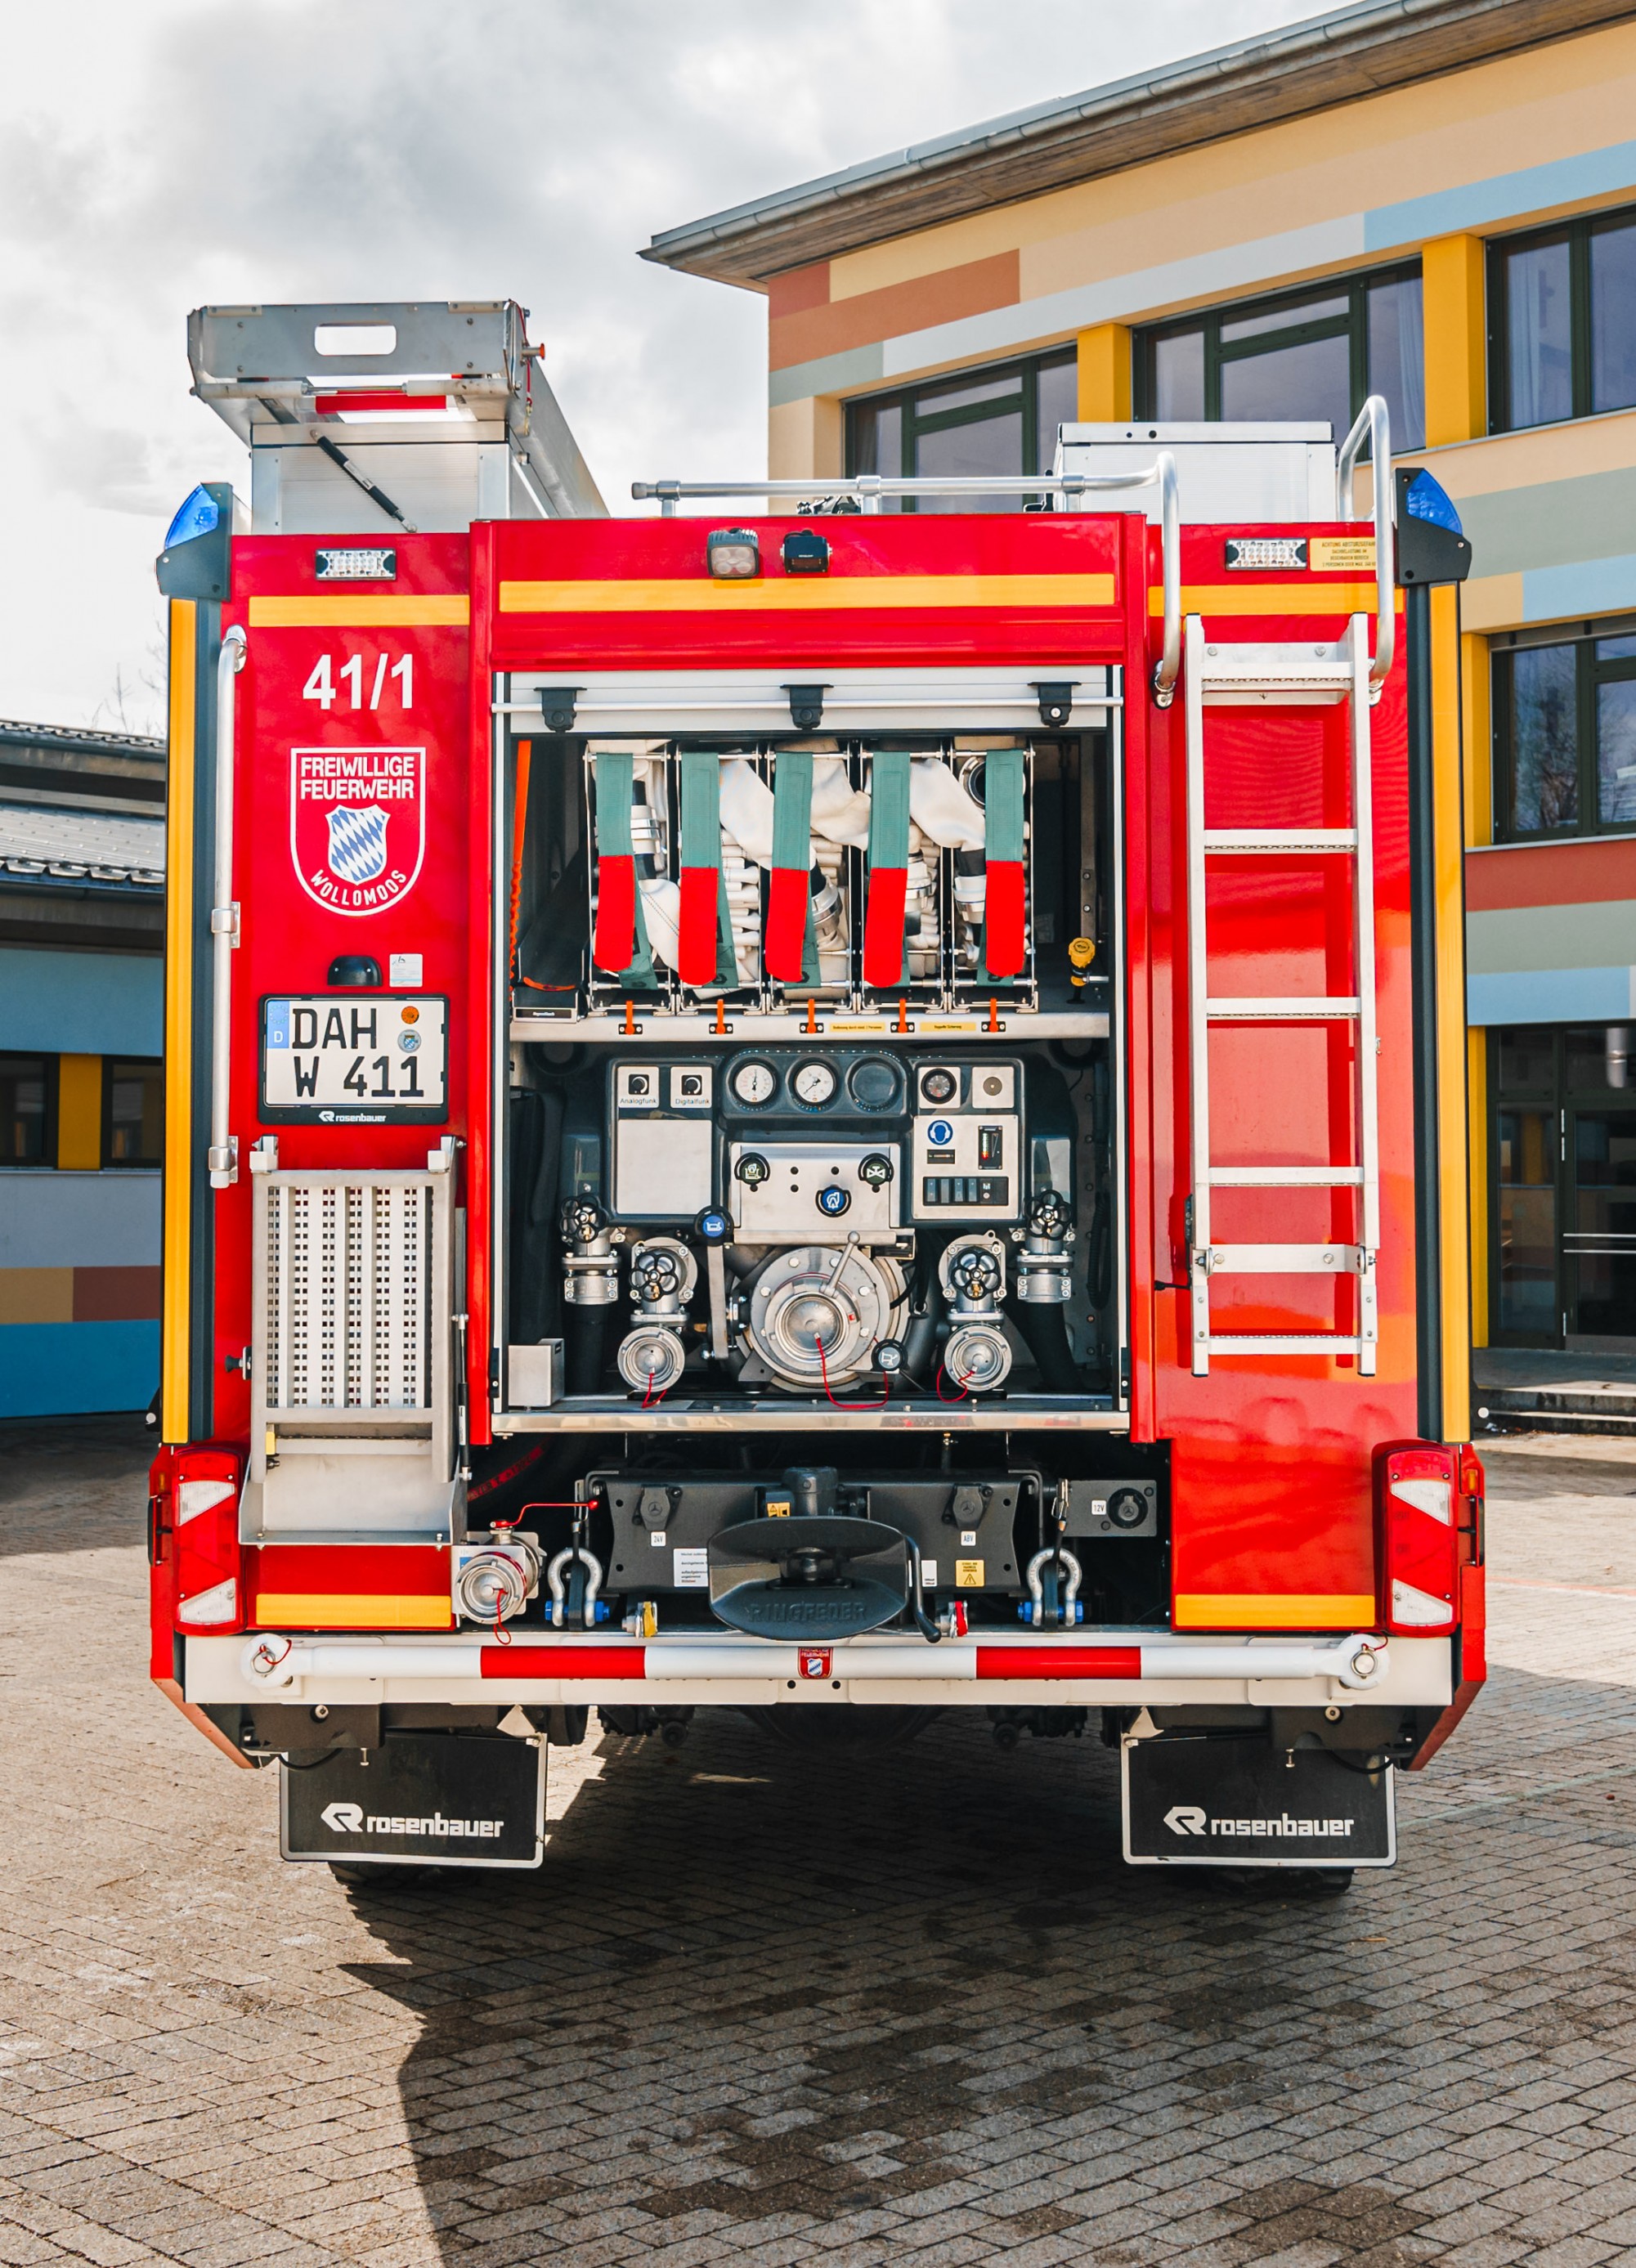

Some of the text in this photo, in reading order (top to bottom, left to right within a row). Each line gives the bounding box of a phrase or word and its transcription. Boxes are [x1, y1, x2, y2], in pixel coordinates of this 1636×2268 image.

[303, 652, 413, 710] 41/1
[300, 755, 415, 778] FREIWILLIGE
[300, 779, 415, 800] FEUERWEHR
[310, 868, 407, 907] WOLLOMOOS
[274, 1031, 284, 1043] D
[292, 1007, 377, 1049] DAH
[294, 1056, 424, 1097] W 411
[335, 1113, 387, 1123] rosenbauer
[750, 1602, 867, 1622] RINGFEDER
[366, 1812, 504, 1837] rosenbauer
[1211, 1813, 1355, 1836] rosenbauer
